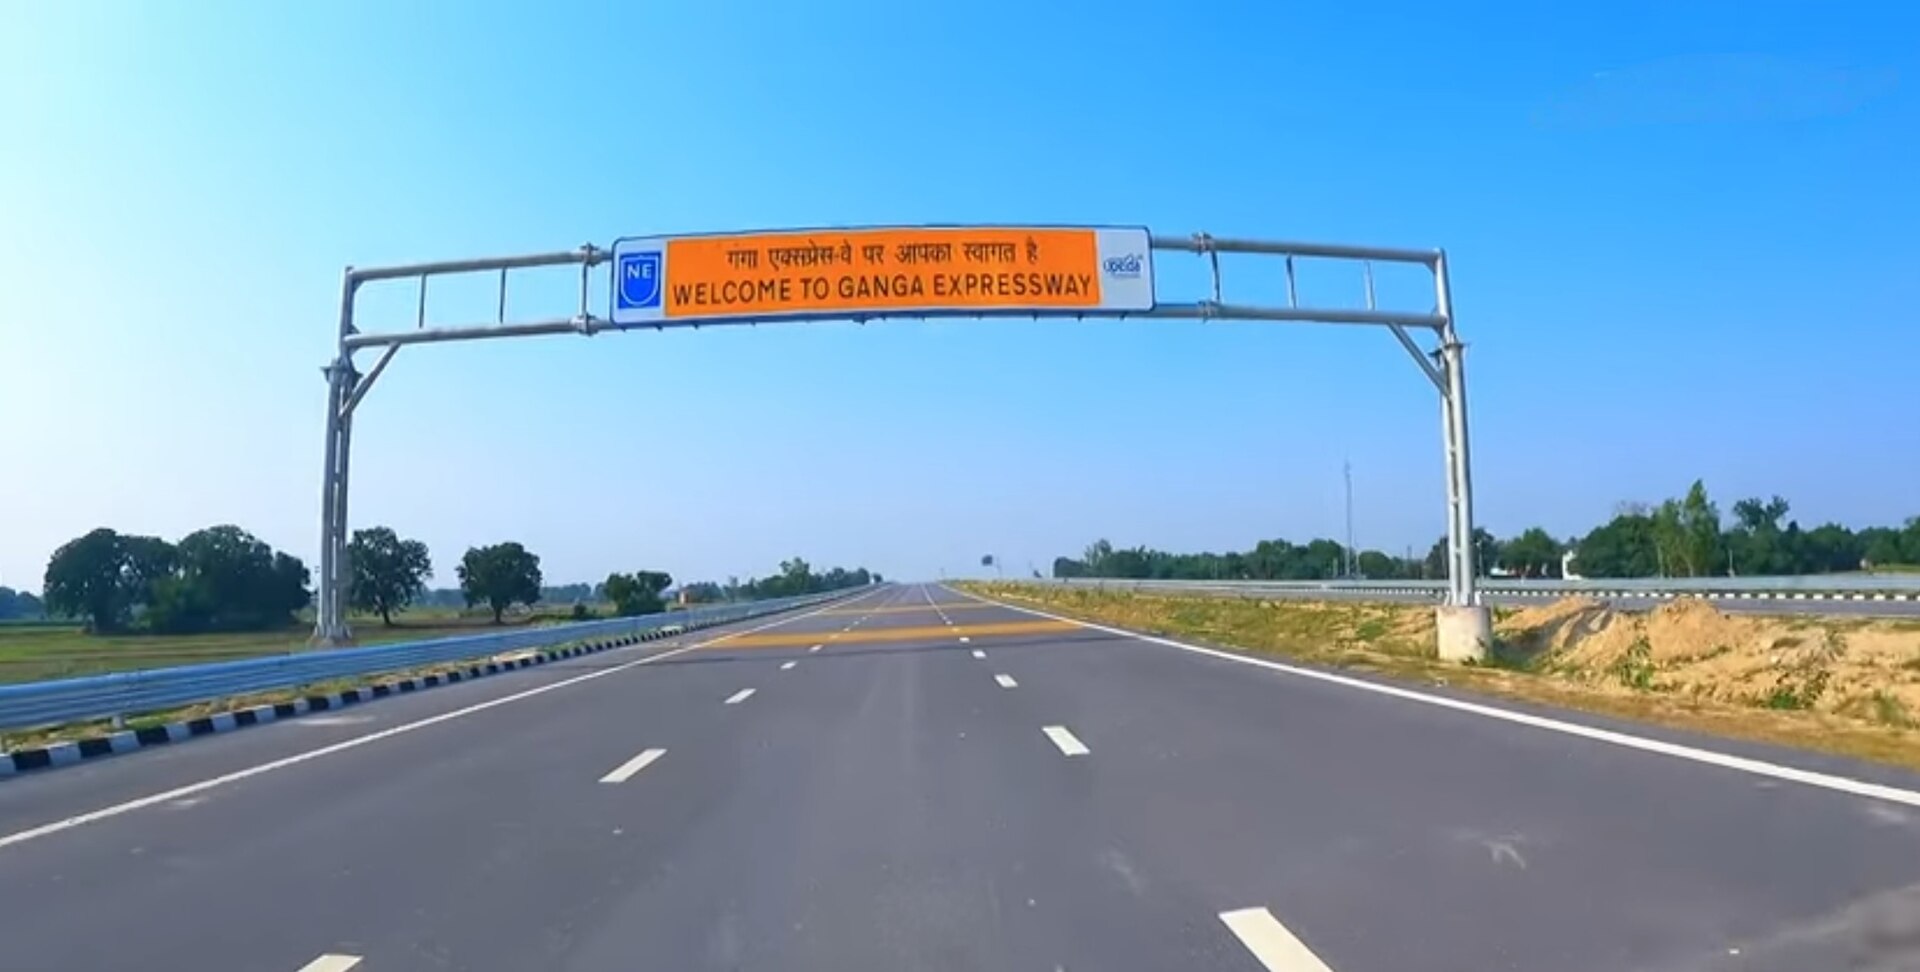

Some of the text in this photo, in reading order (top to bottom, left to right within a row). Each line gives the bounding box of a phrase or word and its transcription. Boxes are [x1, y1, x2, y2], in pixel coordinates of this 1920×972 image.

[726, 244, 758, 269] गंगा
[862, 244, 885, 265] पर
[895, 242, 952, 265] आपका
[963, 242, 1017, 263] स्वागत
[1026, 236, 1039, 264] है
[626, 262, 653, 279] NE
[673, 272, 1091, 306] WELCOME TO GANGA EXPRESSWAY
